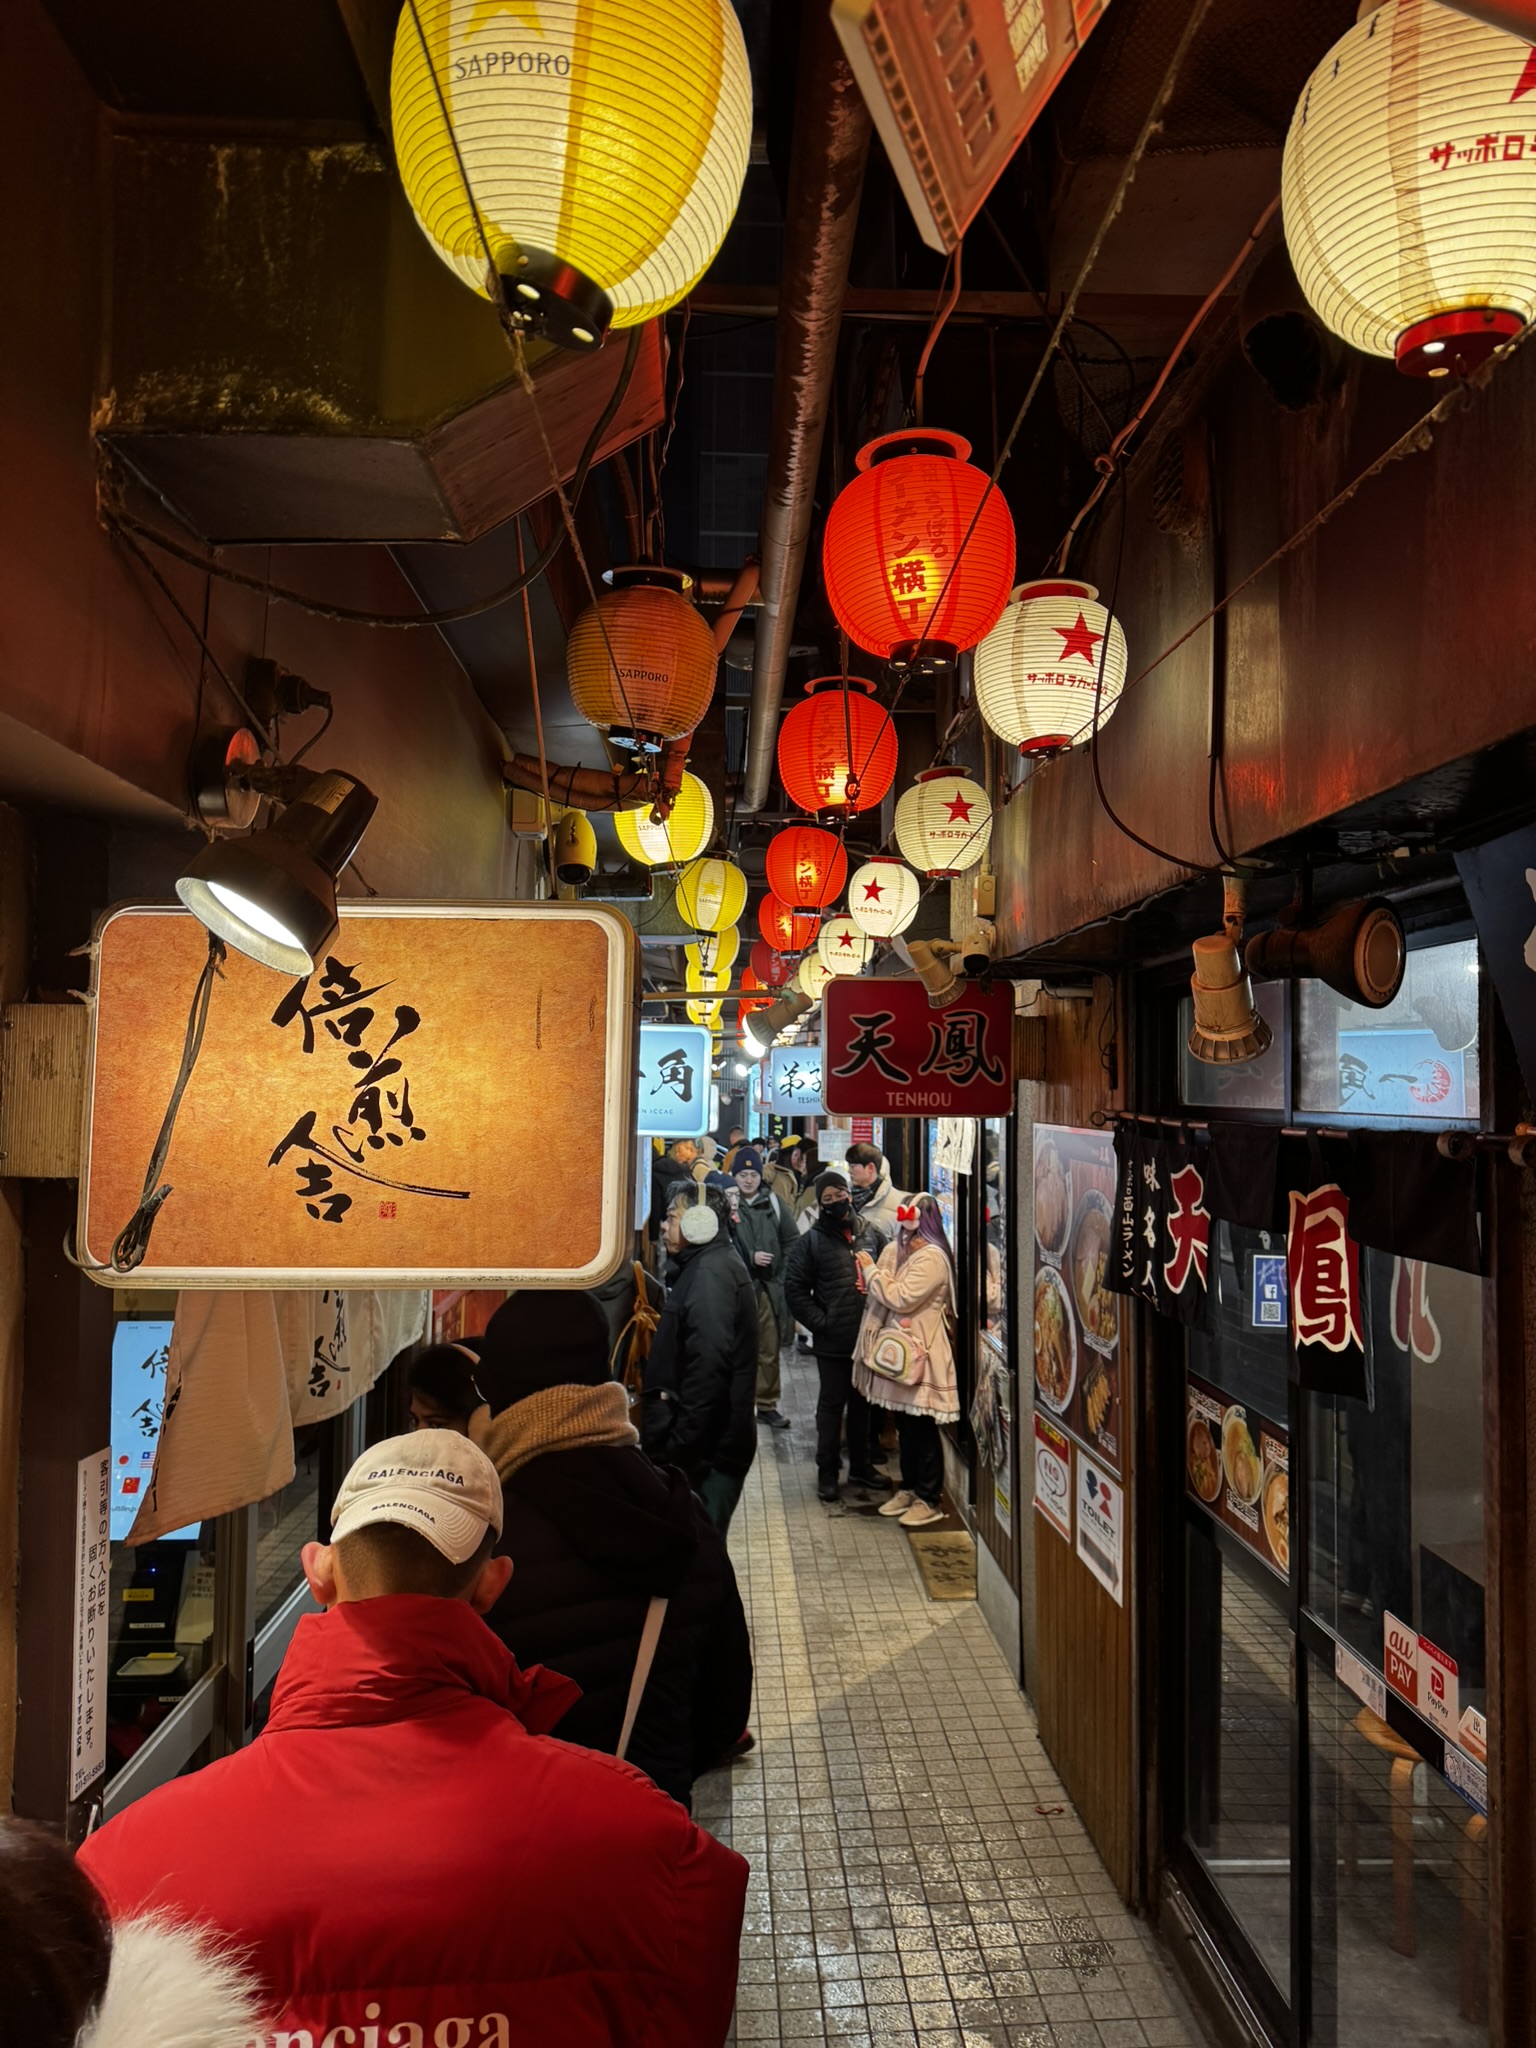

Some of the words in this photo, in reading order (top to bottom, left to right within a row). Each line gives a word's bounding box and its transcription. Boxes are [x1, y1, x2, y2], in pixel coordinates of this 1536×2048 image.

[455, 52, 571, 79] SAPPORO
[1429, 132, 1536, 171] サッポロ
[887, 463, 928, 625] ラーメン横丁
[619, 668, 669, 683] SAPPORO
[1027, 672, 1109, 695] サッポロラガービル
[831, 1010, 1006, 1087] 天鳳
[886, 1091, 952, 1107] TENHOU
[367, 1468, 465, 1487] BALENCIAGA
[371, 1501, 437, 1525] BALENCIAGA
[1081, 1498, 1117, 1540] TOILET
[1389, 1630, 1414, 1660] au
[1390, 1658, 1413, 1688] PAY
[1427, 1691, 1449, 1718] PayPay
